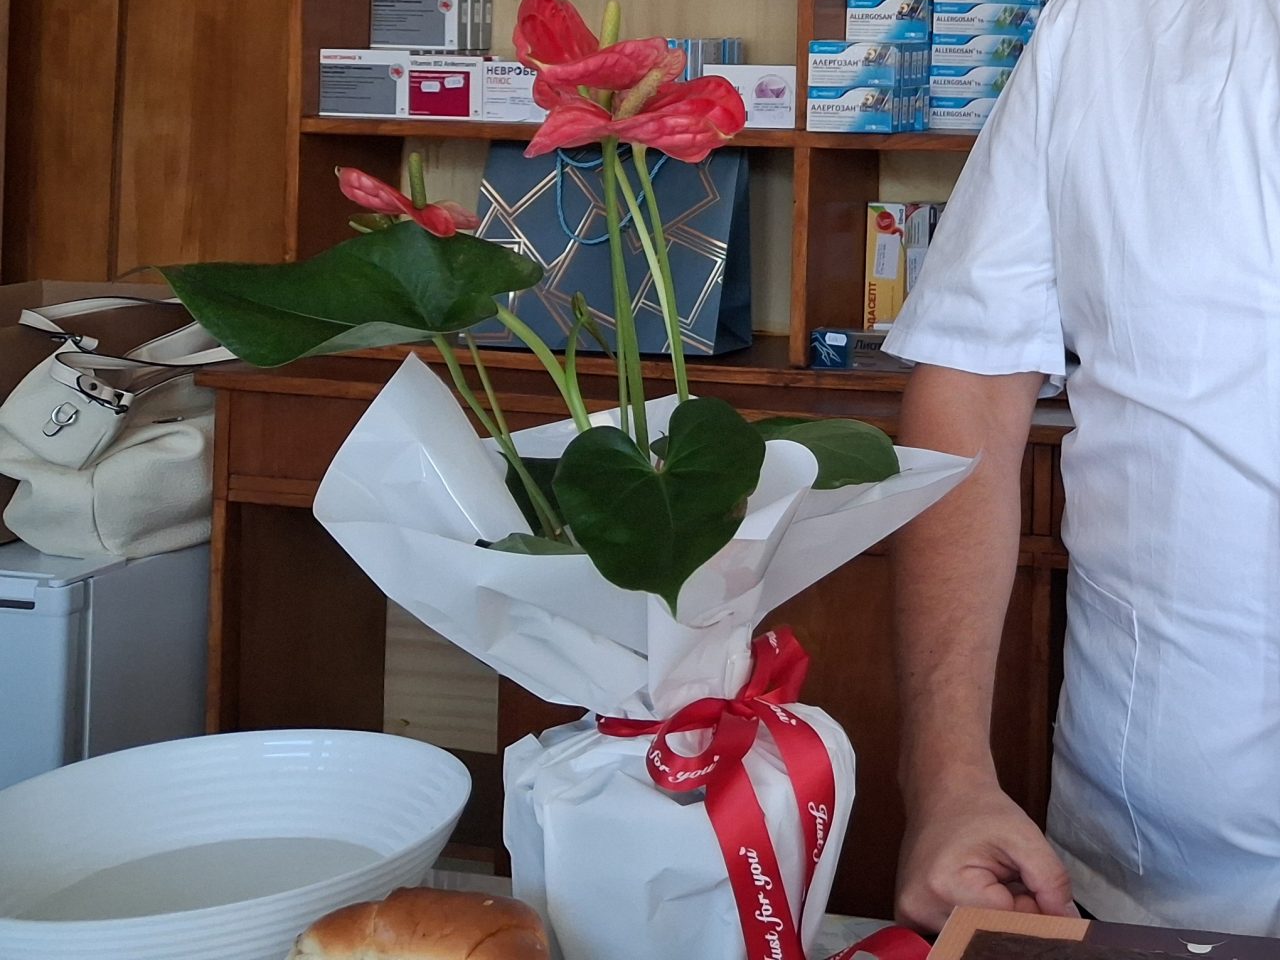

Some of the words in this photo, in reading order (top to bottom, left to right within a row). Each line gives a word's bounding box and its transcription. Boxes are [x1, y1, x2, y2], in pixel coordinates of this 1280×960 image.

[486, 66, 536, 76] НЕВРОБЕ
[649, 750, 670, 773] for
[668, 762, 717, 783] you
[745, 847, 773, 890] you
[755, 891, 784, 931] for
